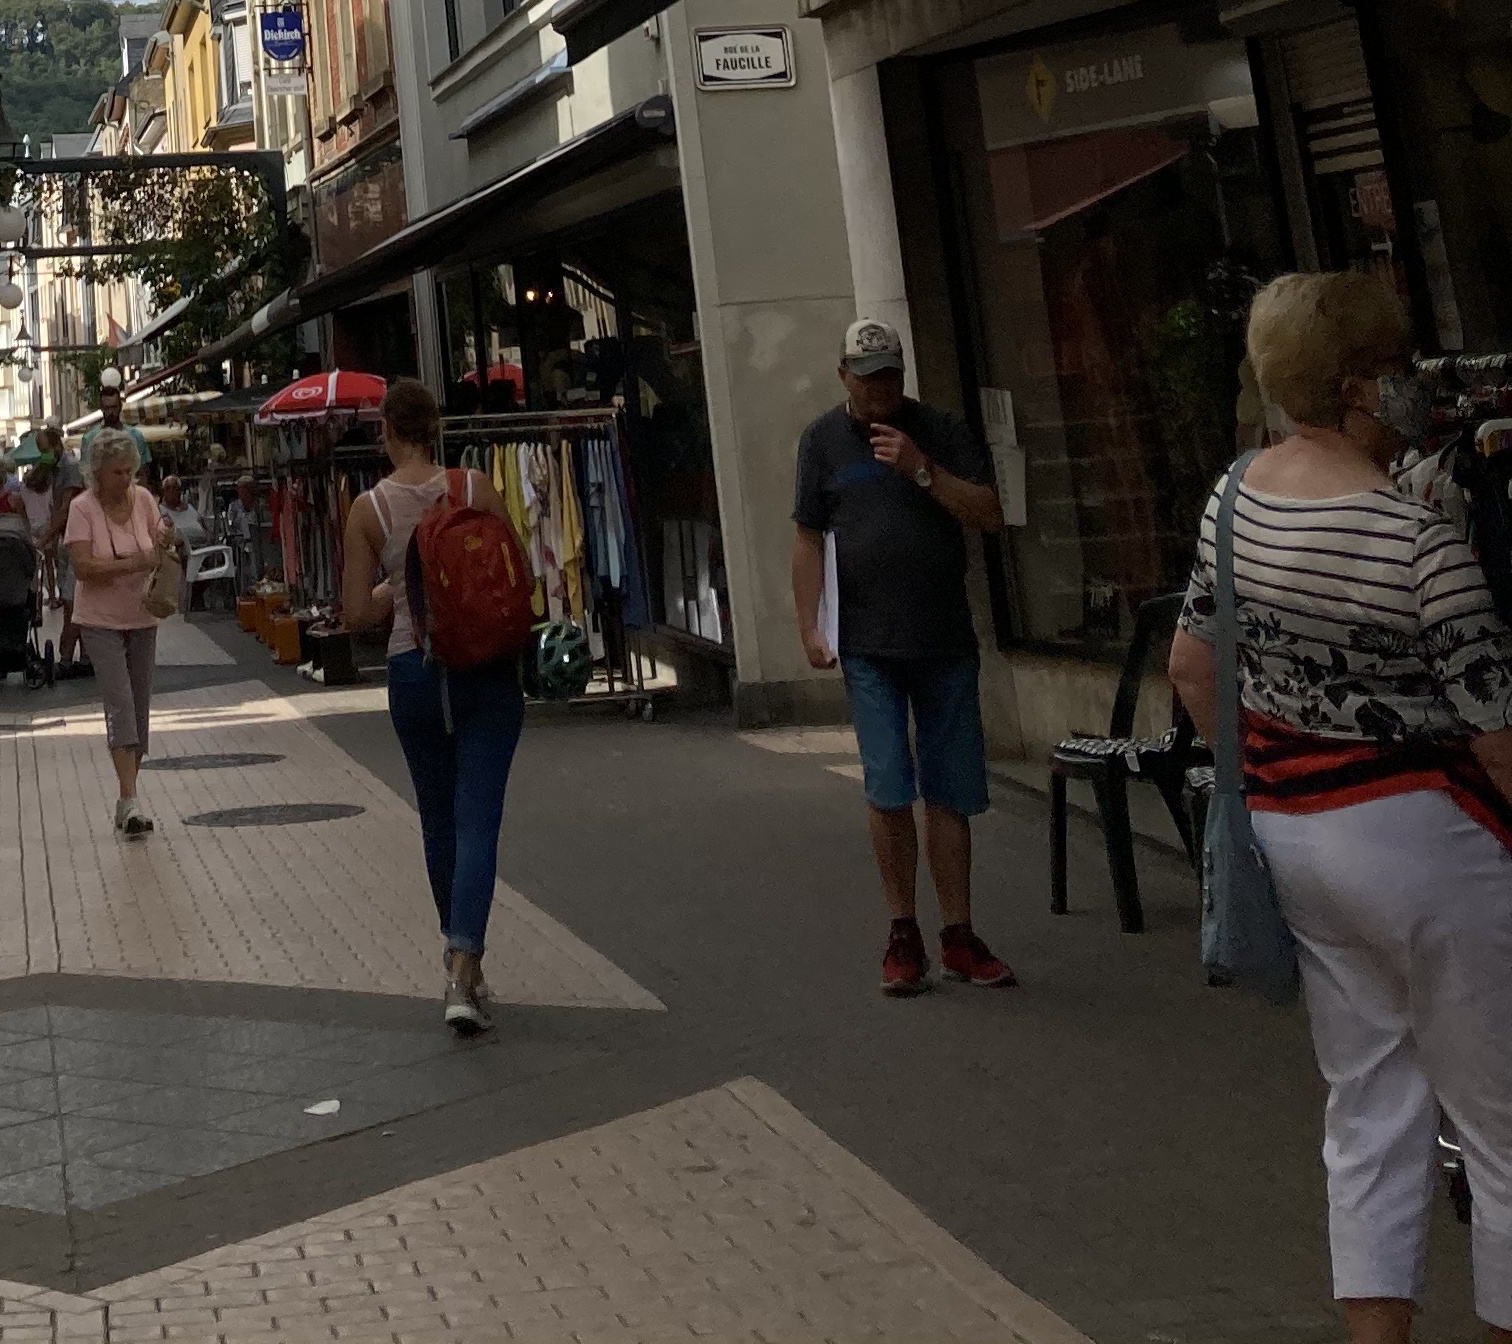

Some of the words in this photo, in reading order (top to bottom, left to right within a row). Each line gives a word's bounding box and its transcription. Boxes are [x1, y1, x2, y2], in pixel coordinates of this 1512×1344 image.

[263, 28, 302, 41] Diekirch
[723, 46, 738, 54] RUE
[739, 45, 749, 53] DE
[751, 45, 760, 53] LA
[715, 56, 772, 70] FAUCILLE
